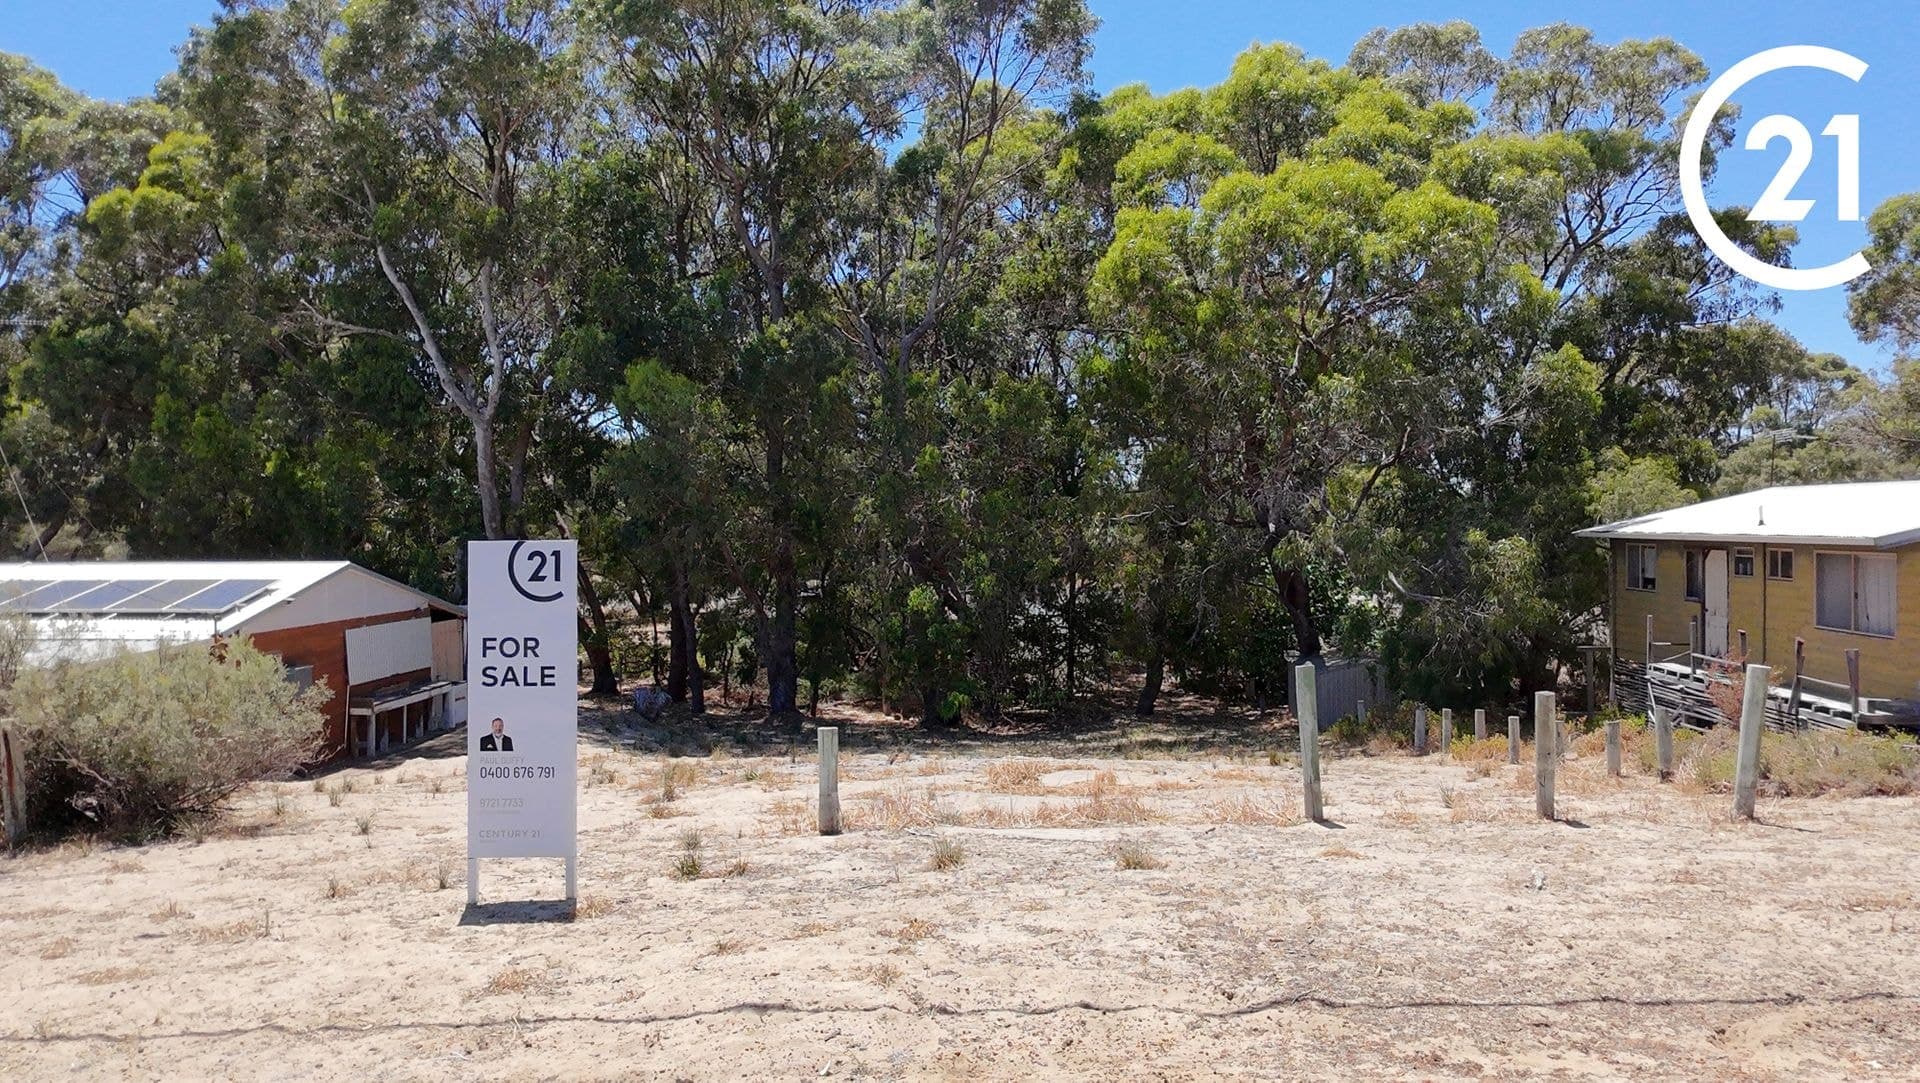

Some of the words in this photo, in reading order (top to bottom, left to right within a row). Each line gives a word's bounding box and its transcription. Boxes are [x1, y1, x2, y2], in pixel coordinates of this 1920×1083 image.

[481, 636, 540, 658] FOR
[481, 665, 556, 687] SALE
[480, 766, 510, 779] 0400
[513, 766, 534, 779] 676
[537, 766, 555, 779] 791
[479, 830, 529, 839] CENTURY
[531, 830, 541, 839] 21
